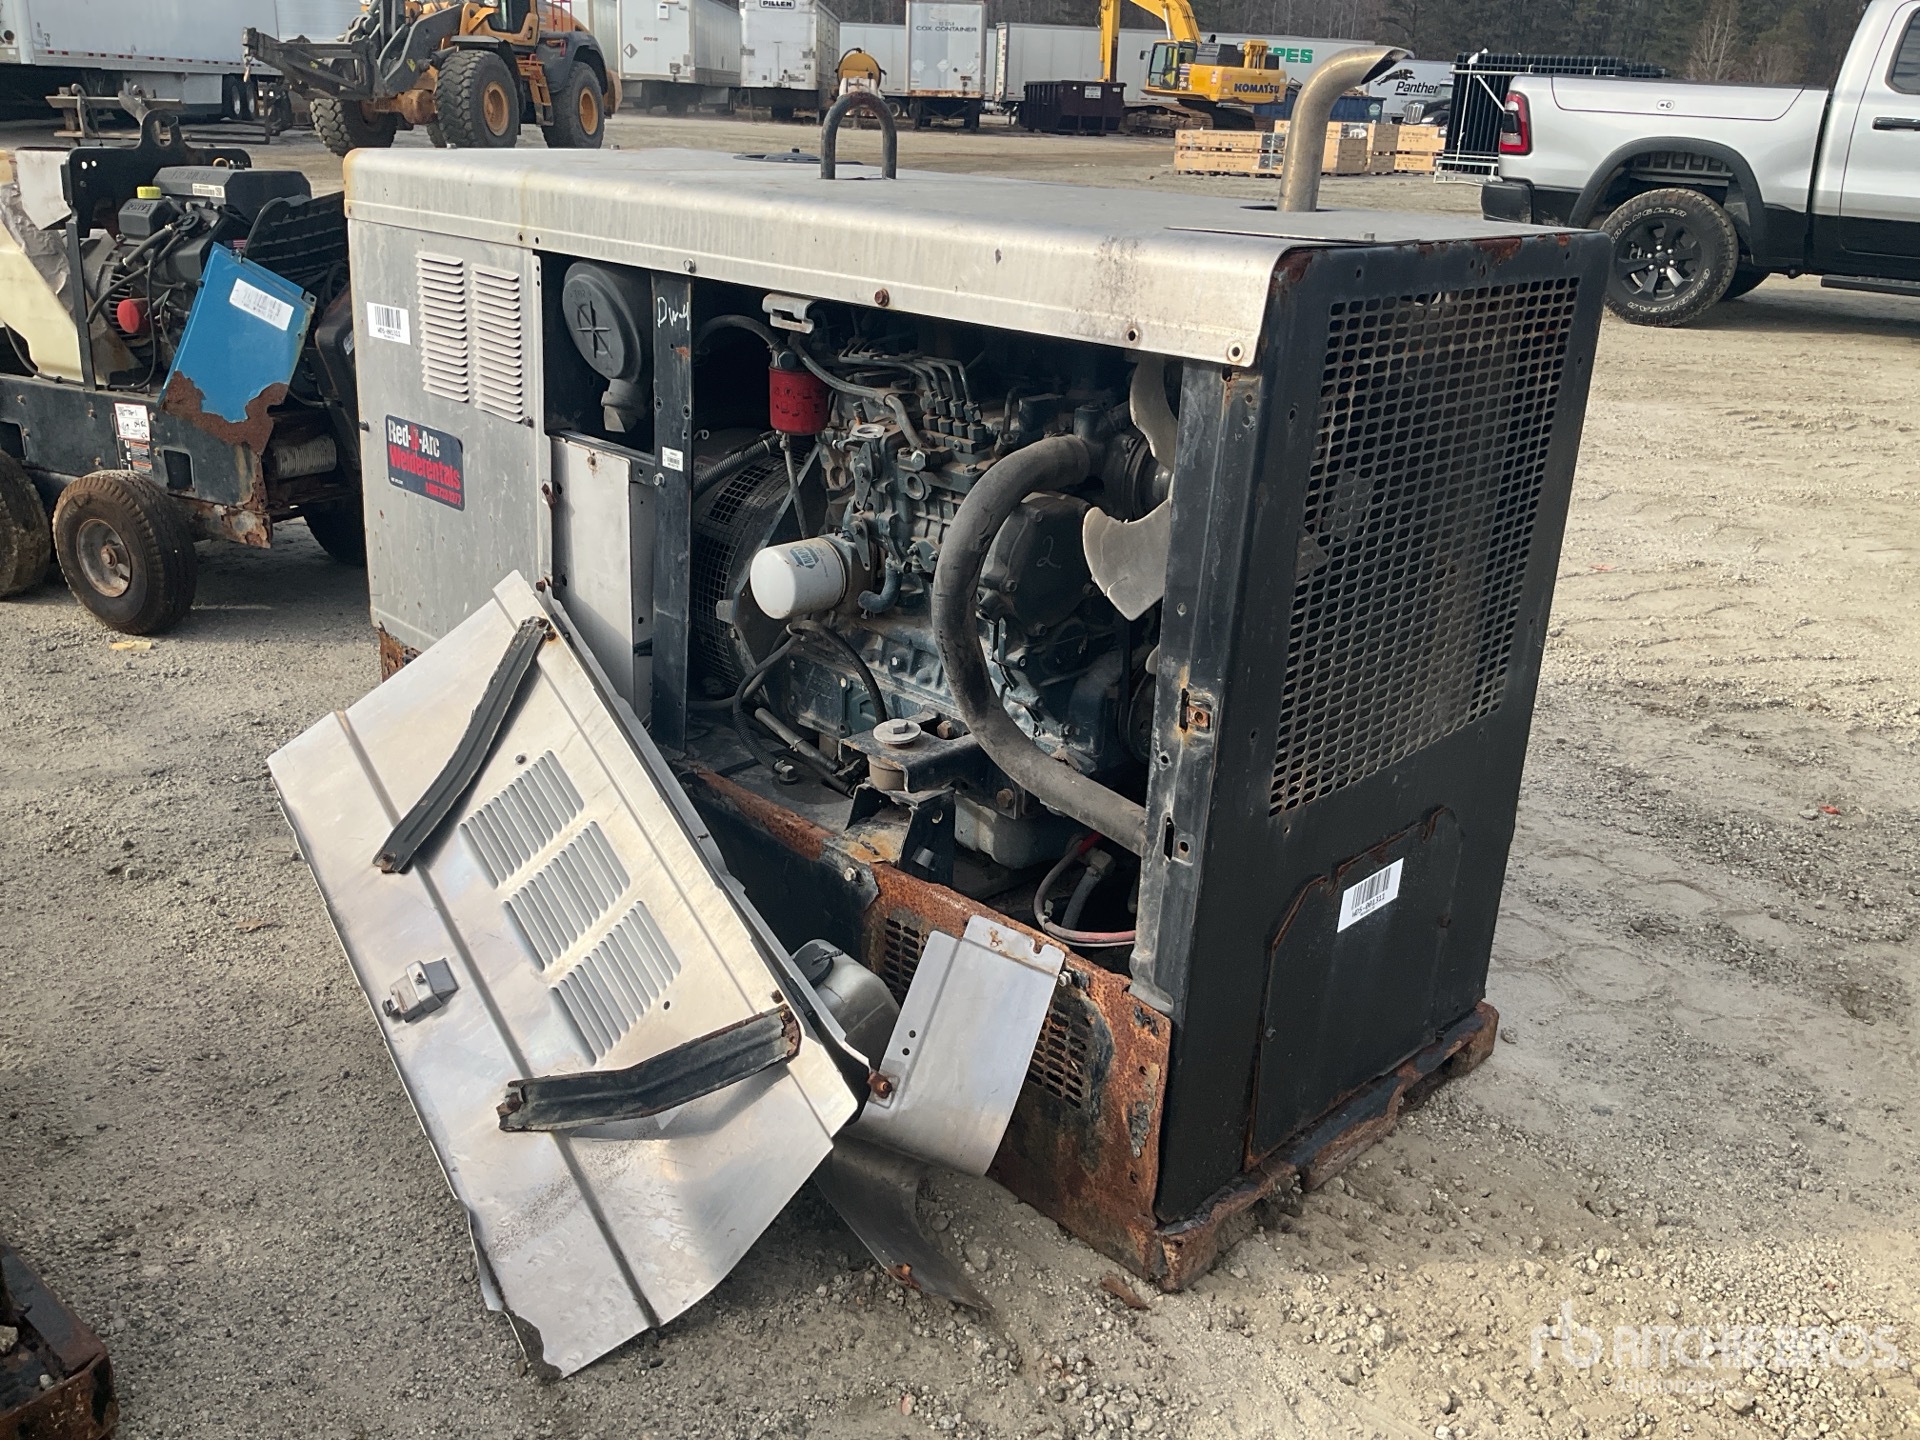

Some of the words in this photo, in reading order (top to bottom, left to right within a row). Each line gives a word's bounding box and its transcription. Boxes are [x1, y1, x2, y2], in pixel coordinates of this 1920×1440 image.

[1268, 47, 1313, 63] PES
[1234, 82, 1280, 94] KOMATSU
[1396, 81, 1438, 94] Panther
[389, 444, 462, 490] Welderentals
